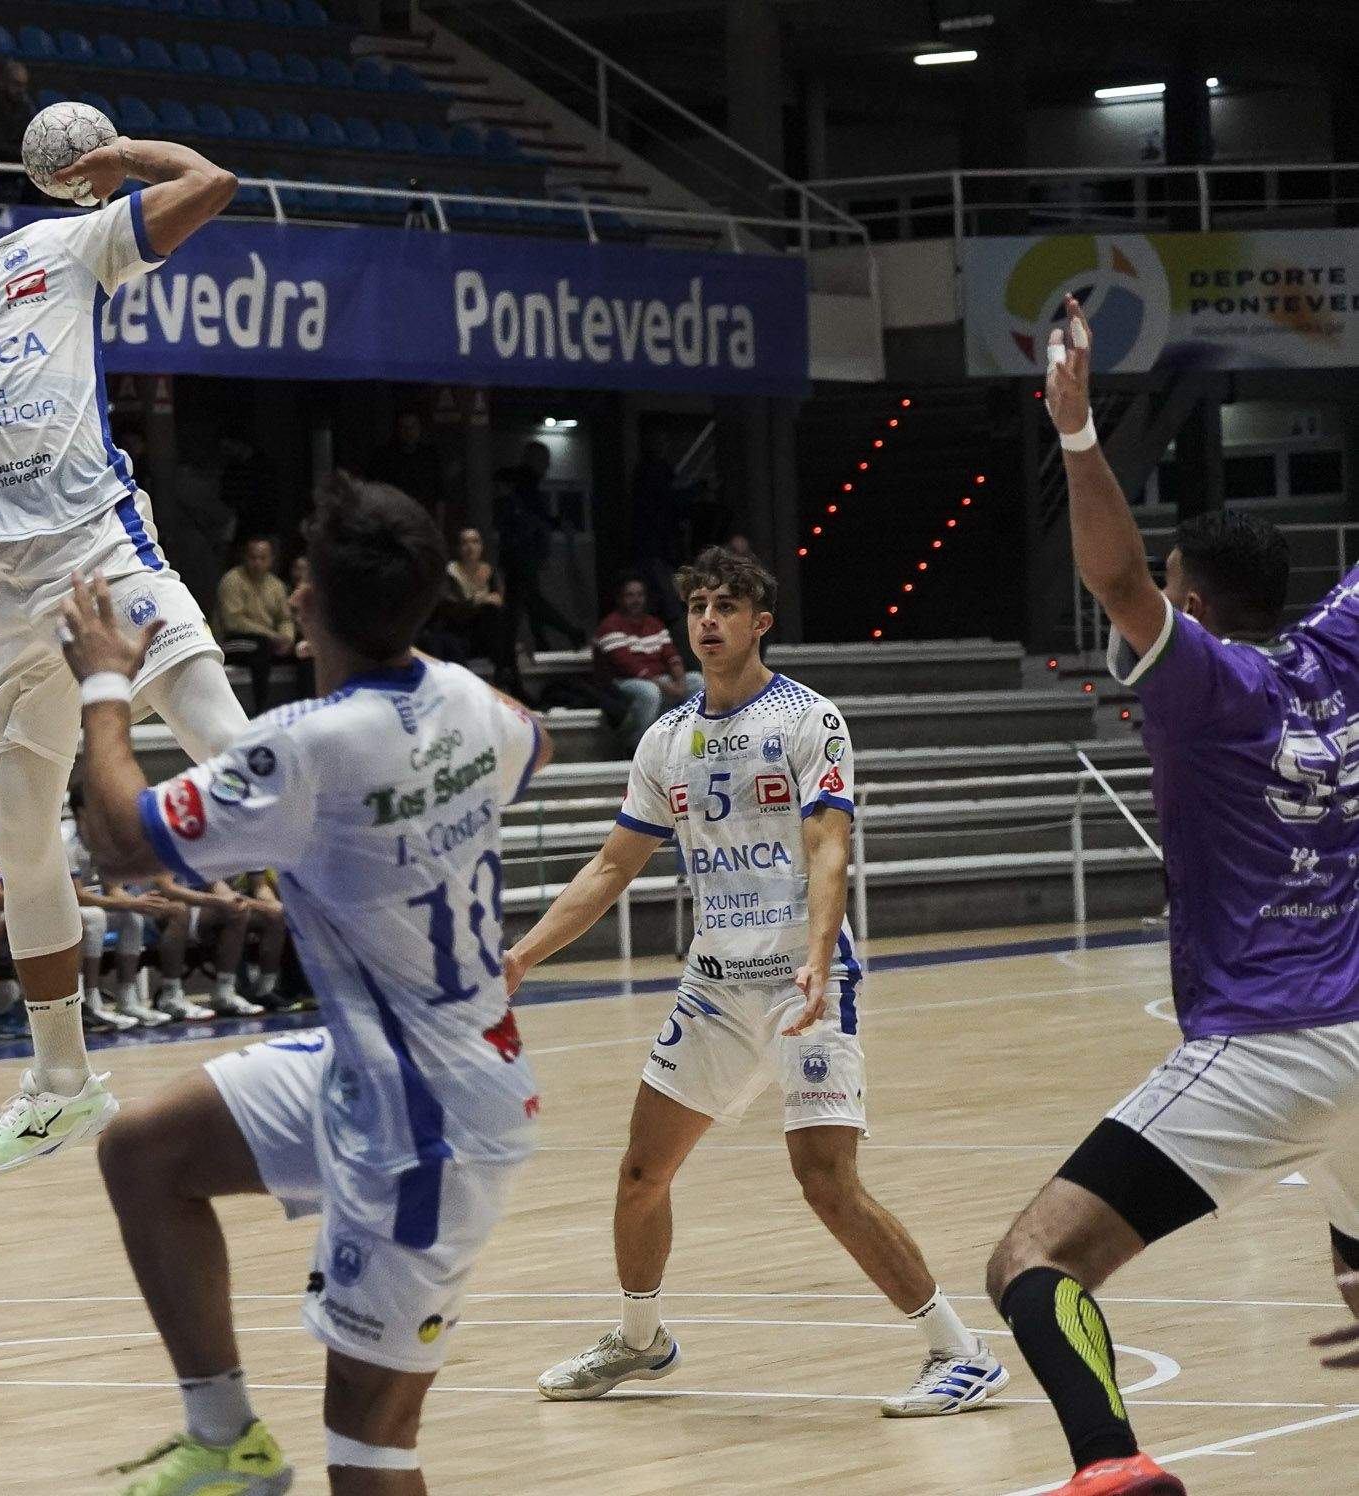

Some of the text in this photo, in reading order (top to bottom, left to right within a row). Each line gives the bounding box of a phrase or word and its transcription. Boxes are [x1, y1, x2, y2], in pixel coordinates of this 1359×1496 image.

[1189, 267, 1346, 288] DEPORTE
[453, 269, 756, 368] Pontevedra
[148, 622, 194, 650] eputación
[707, 733, 750, 755] ence
[704, 772, 732, 822] 5
[691, 841, 792, 875] BANCA
[704, 892, 760, 911] XUNTA
[706, 904, 793, 929] DE GALICIA
[725, 953, 791, 971] Deputación
[726, 965, 793, 981] Pontevedra
